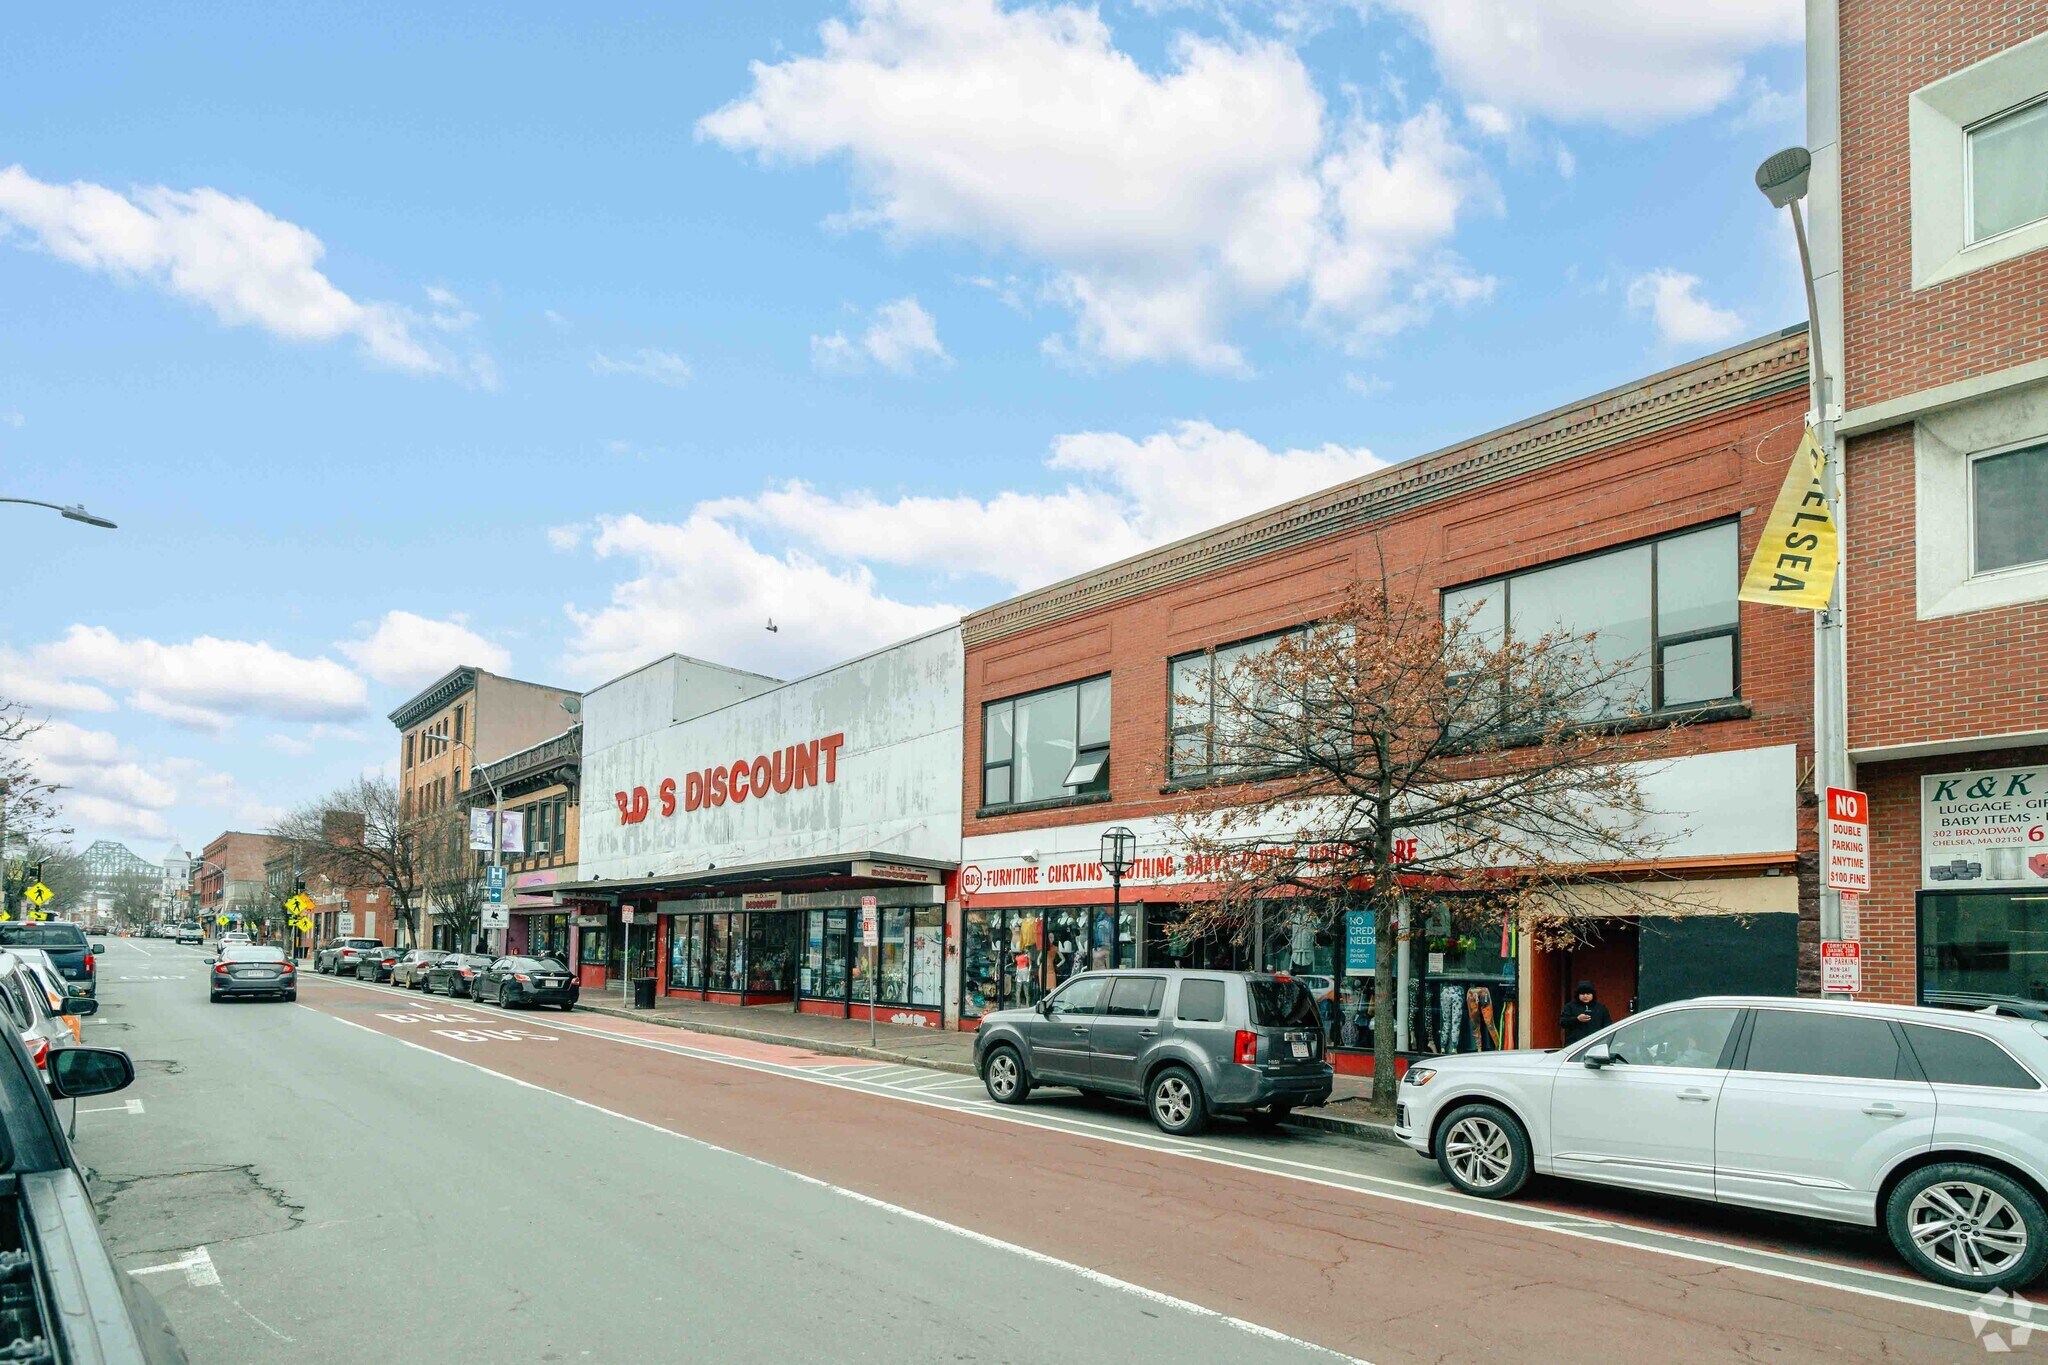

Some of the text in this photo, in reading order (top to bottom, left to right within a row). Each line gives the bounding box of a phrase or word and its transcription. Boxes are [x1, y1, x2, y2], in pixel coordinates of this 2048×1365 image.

[685, 732, 844, 812] DISCOUNT
[1931, 773, 2036, 801] K & K
[1836, 794, 1858, 818] NO
[1940, 801, 2012, 814] LUGGAGE
[1942, 813, 2031, 827] BABY ITEMS
[1833, 823, 1862, 837] DOUBLE
[1932, 826, 2023, 838] 302 BROADWAY
[2028, 825, 2044, 842] 6
[1832, 839, 1864, 853] PARKING
[1995, 836, 2023, 844] 02150
[1831, 855, 1864, 868] ANYTIME
[492, 867, 503, 878] H
[871, 868, 928, 881] DISCOUNT
[987, 866, 1039, 887] FURNITURE
[1048, 862, 1102, 883] CURTAINS
[1113, 856, 1174, 880] OTHING
[1849, 873, 1866, 885] FINE
[1349, 916, 1364, 926] NO
[1349, 926, 1376, 935] CREDI
[1349, 936, 1377, 945] NEEDE
[1834, 958, 1857, 966] PARKING
[375, 1013, 497, 1024] BIKE
[429, 1029, 560, 1043] BUS
